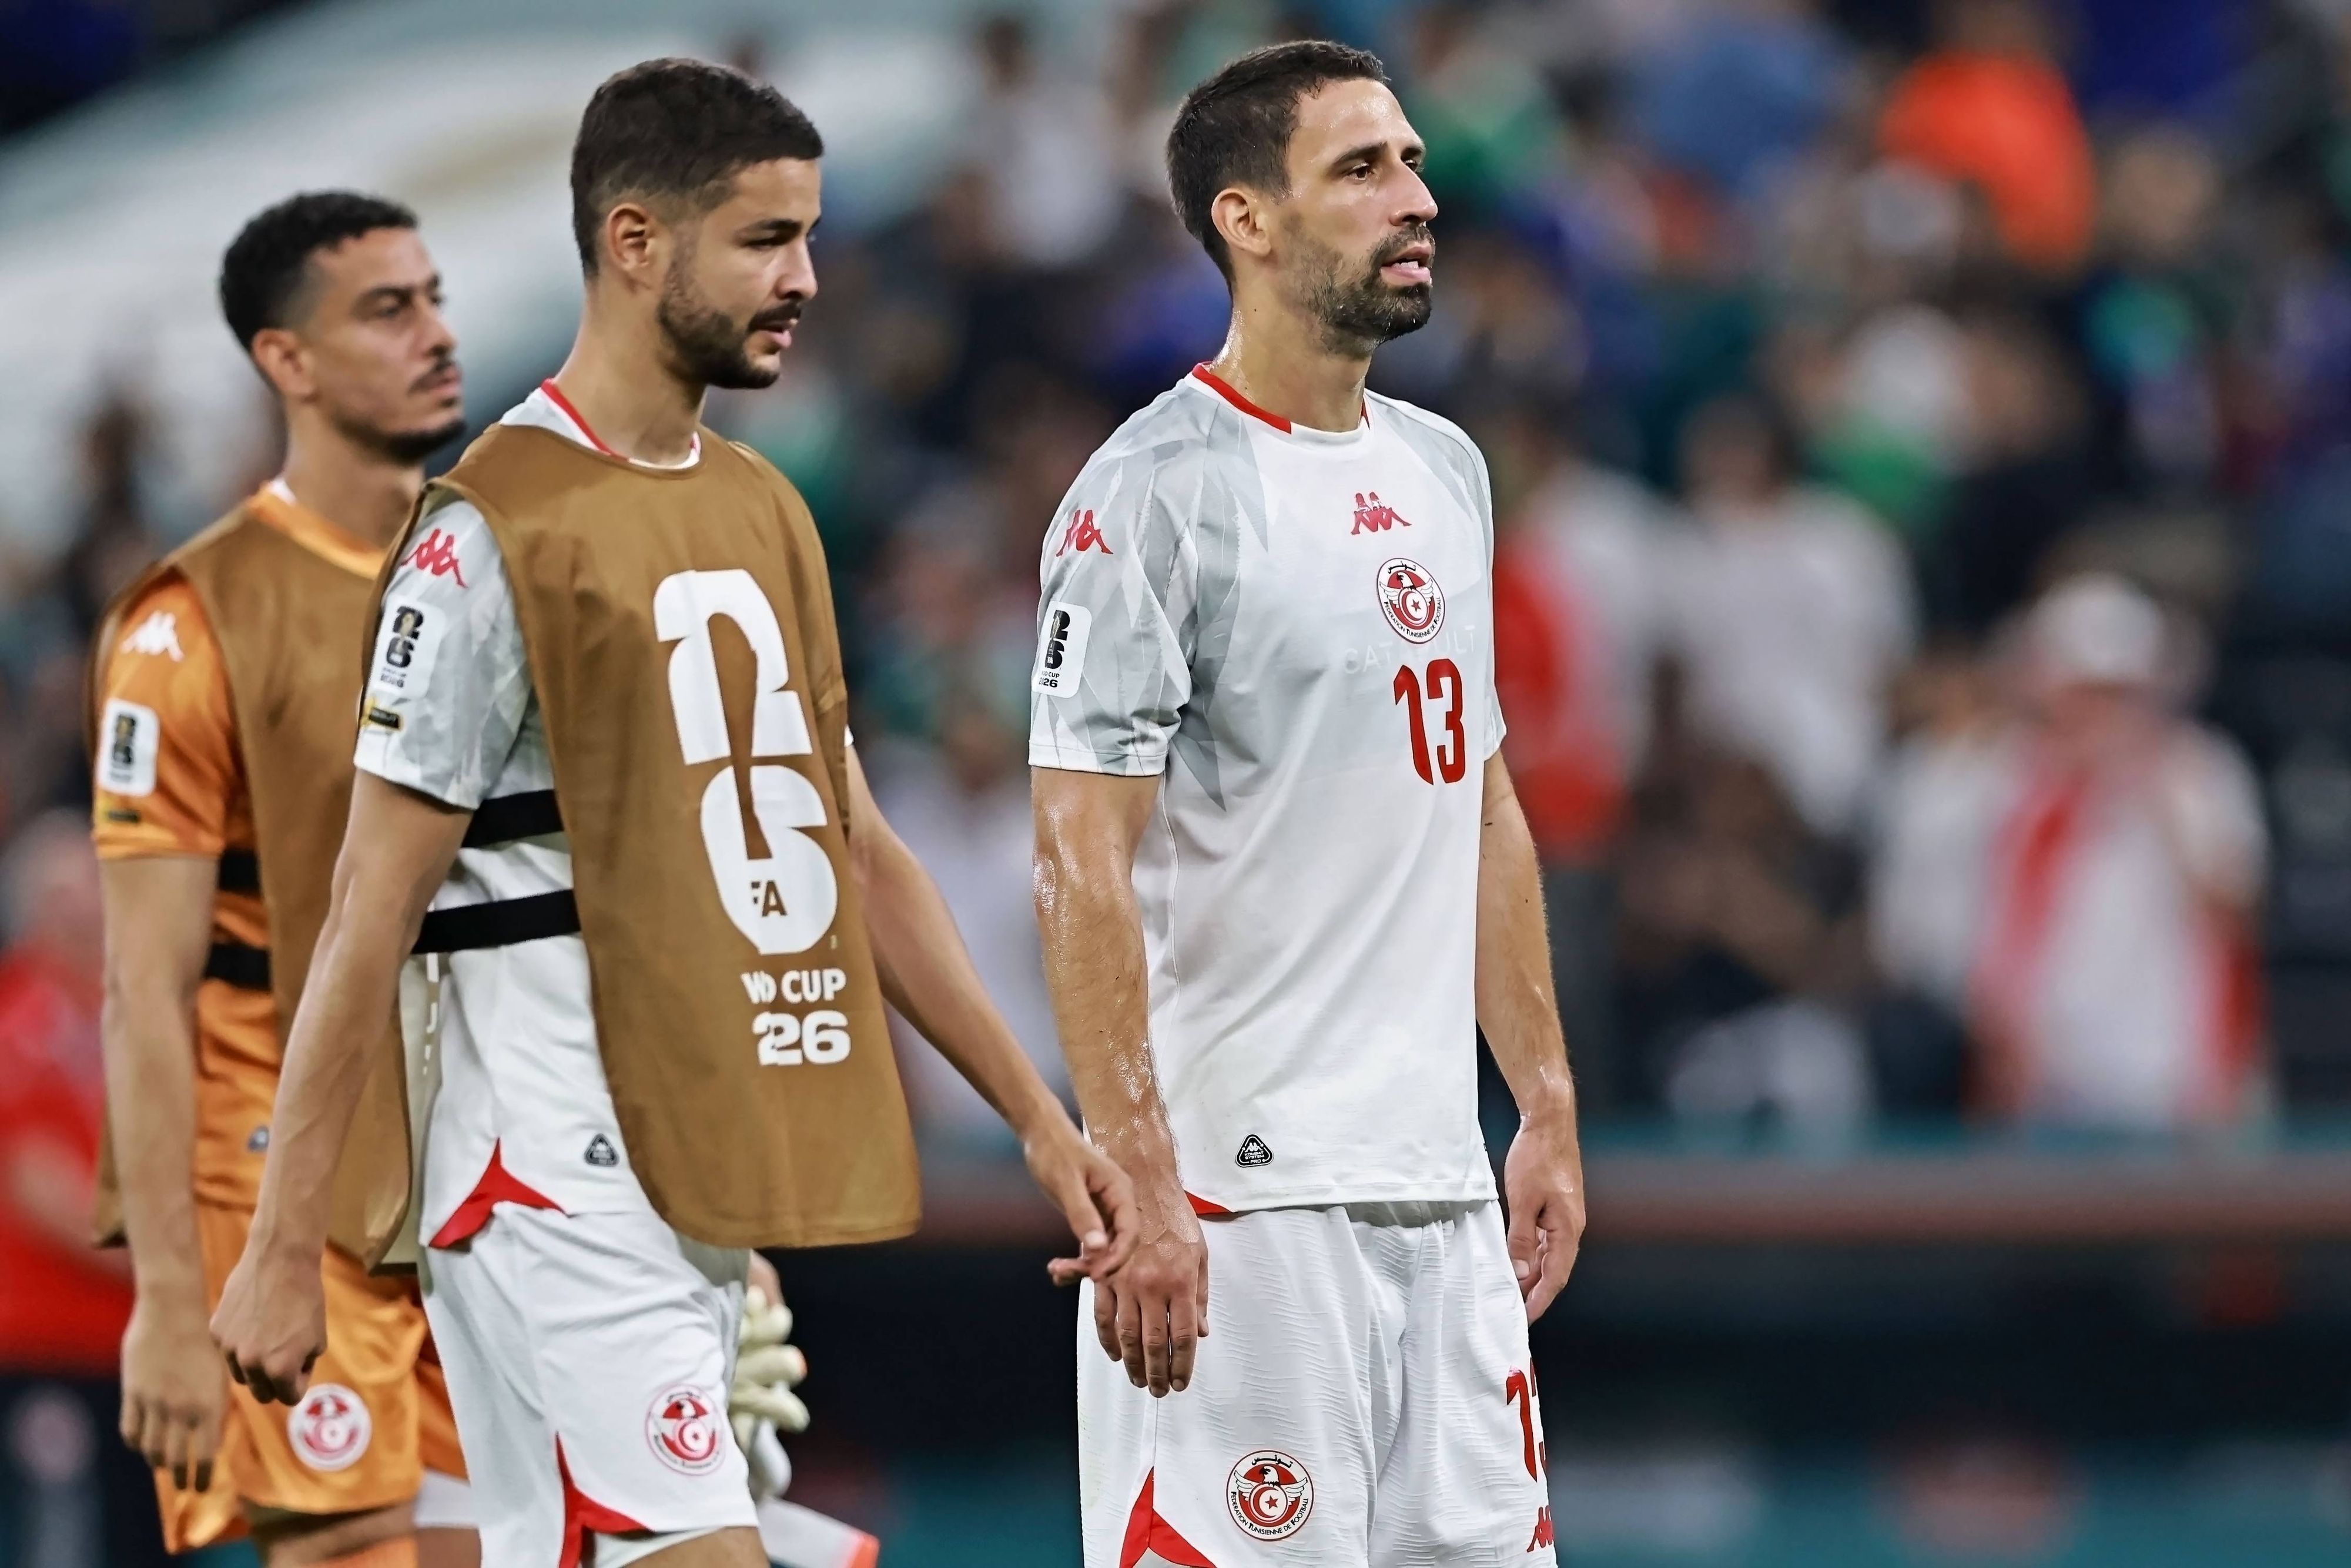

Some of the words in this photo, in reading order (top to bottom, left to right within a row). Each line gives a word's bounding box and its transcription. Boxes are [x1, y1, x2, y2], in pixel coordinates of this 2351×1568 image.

[1384, 601, 1405, 632] FEDERATION
[1394, 658, 1466, 785] 13
[781, 967, 847, 1004] CUP
[1251, 1455, 1294, 1468] تونس
[1231, 1491, 1248, 1526] FEDERATION
[1248, 1523, 1283, 1535] TUNISIENNE
[1291, 1498, 1308, 1526] FOOTBALL
